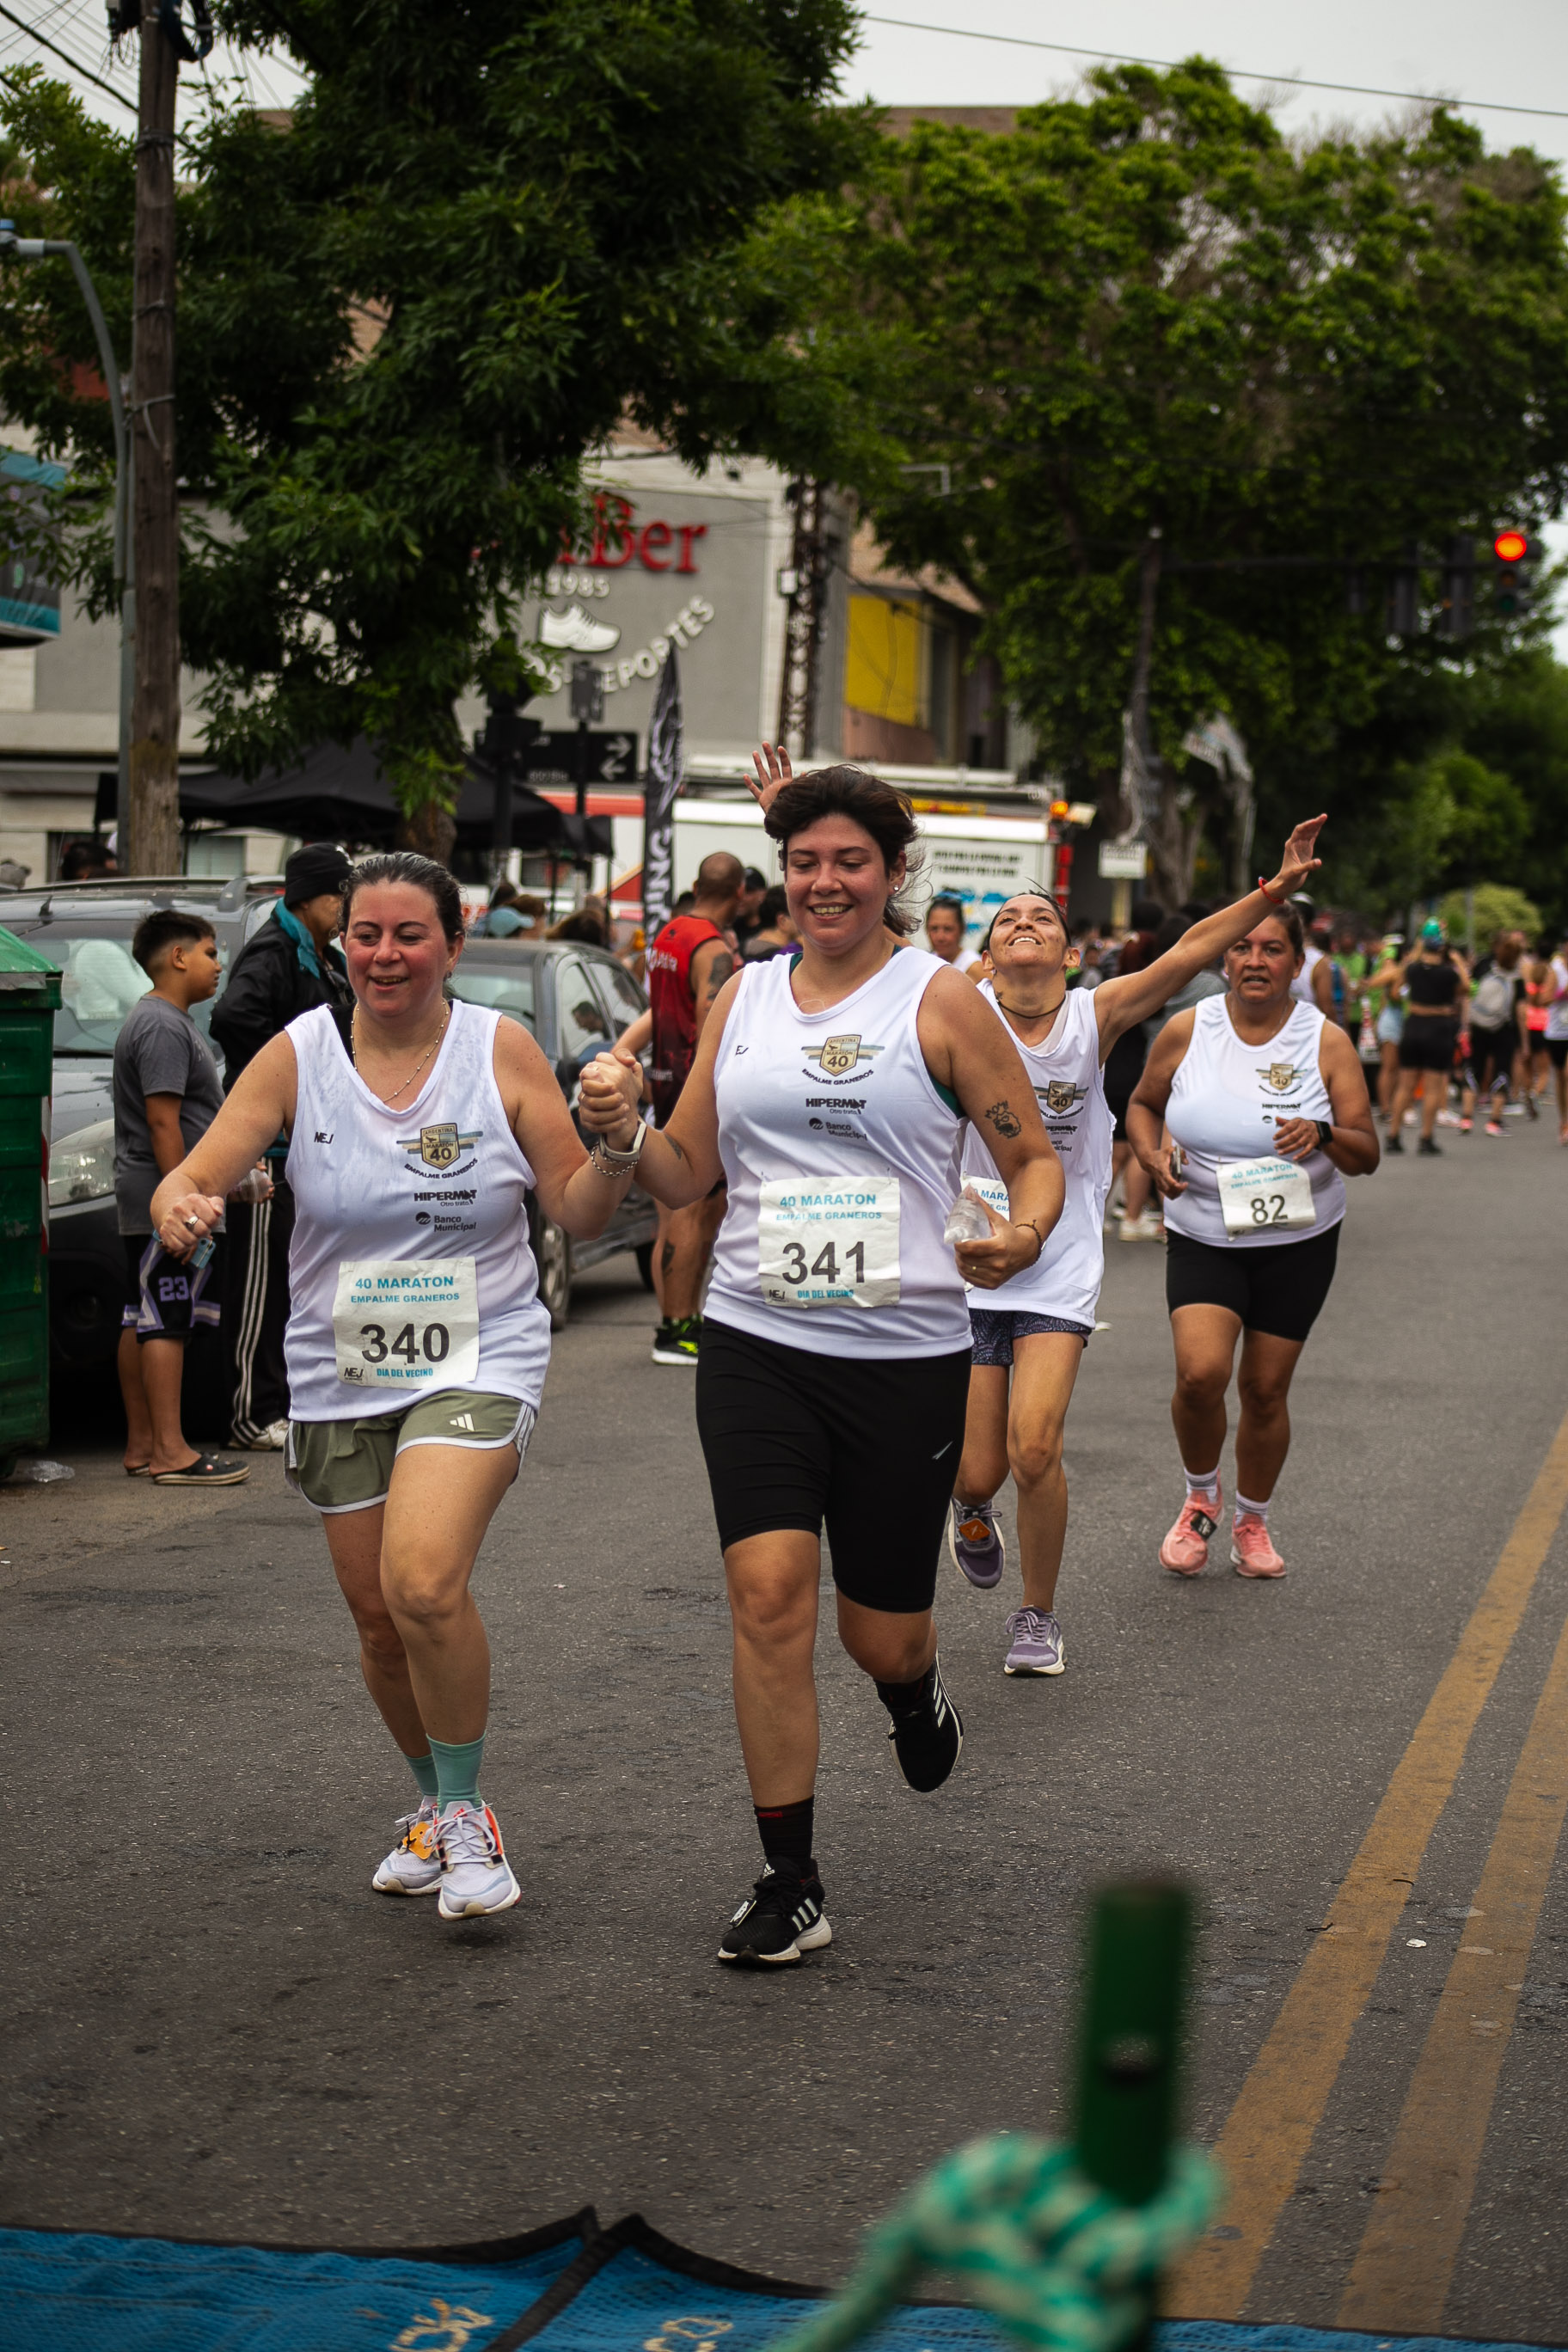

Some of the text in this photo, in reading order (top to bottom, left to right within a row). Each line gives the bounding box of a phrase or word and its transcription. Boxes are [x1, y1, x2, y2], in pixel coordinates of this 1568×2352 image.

[600, 595, 715, 694] EPORTES
[827, 1055, 848, 1068] 40
[801, 1069, 874, 1086] EMPALME GRANEROS
[1052, 1098, 1068, 1107] 40
[825, 1122, 852, 1130] Banco
[314, 1131, 334, 1144] NEJ
[430, 1148, 452, 1161] 40
[404, 1157, 479, 1179] EMPALME GRANEROS
[1246, 1164, 1293, 1176] MARATON
[780, 1194, 877, 1208] 40 MARATON
[776, 1211, 882, 1221] EMPALME GRANEROS
[1250, 1194, 1289, 1225] 82
[434, 1215, 462, 1223] Banco
[433, 1222, 477, 1233] Municipal
[782, 1240, 865, 1285] 341
[158, 1276, 189, 1302] 23
[355, 1276, 454, 1289] 40 MARATON
[351, 1293, 460, 1303] EMPALME GRANEROS
[769, 1289, 786, 1300] NEJ
[812, 1289, 825, 1299] DEL
[360, 1322, 450, 1364] 340
[344, 1367, 364, 1378] NEJ
[391, 1369, 404, 1378] DEL
[405, 1368, 433, 1378] VECINO
